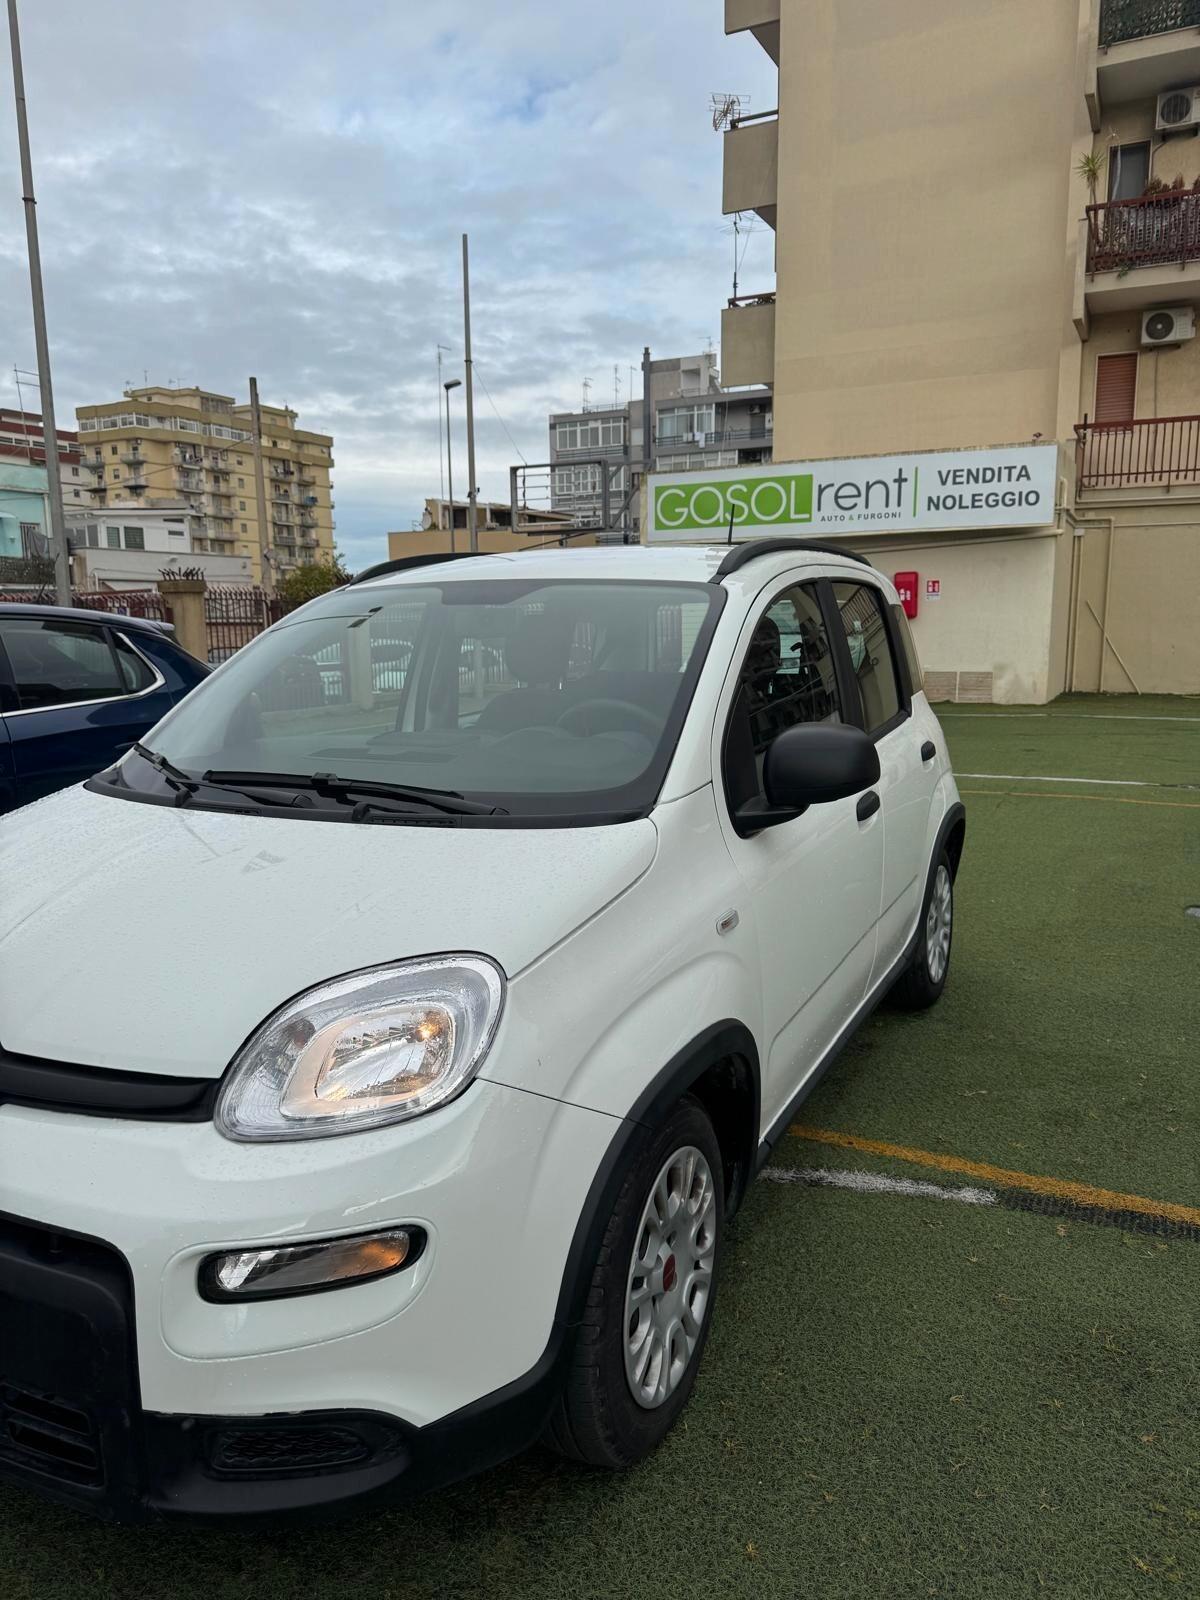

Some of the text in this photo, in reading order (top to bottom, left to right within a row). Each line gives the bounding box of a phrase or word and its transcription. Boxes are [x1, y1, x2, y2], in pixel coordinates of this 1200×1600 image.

[937, 464, 1031, 486] VENDITA
[818, 468, 908, 511] rent
[927, 490, 1040, 511] NOLEGGIO
[820, 514, 846, 522] AUTO
[857, 511, 901, 521] FURGONI
